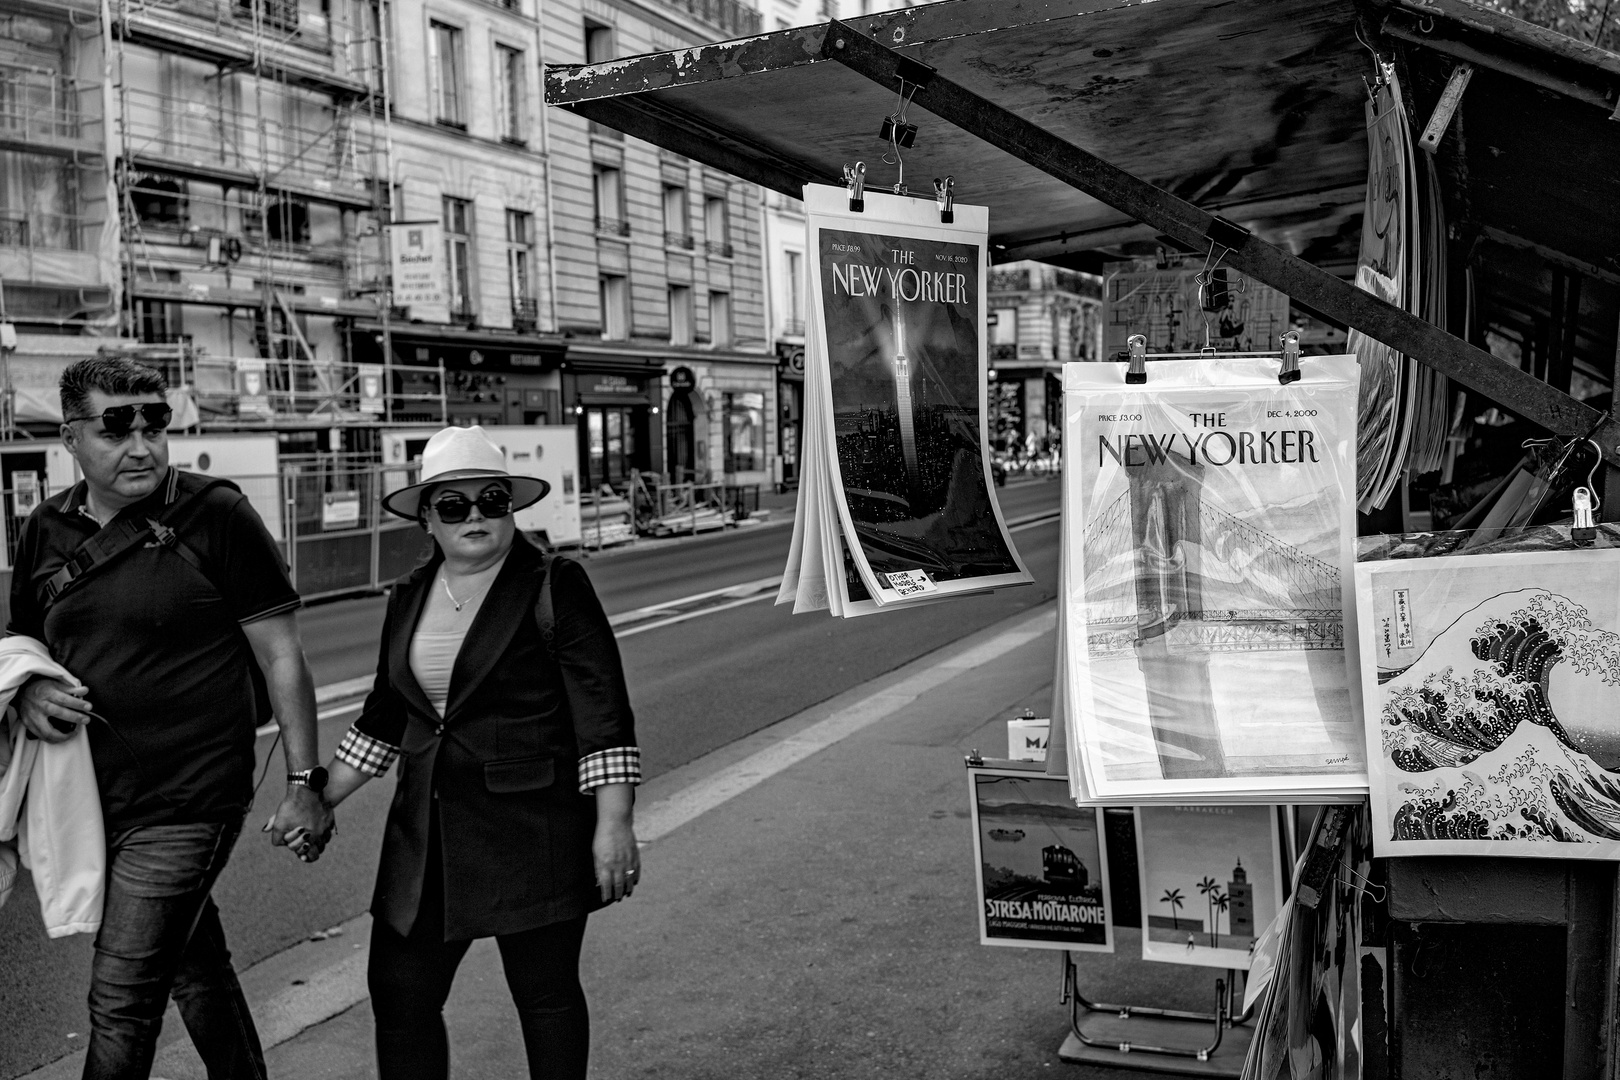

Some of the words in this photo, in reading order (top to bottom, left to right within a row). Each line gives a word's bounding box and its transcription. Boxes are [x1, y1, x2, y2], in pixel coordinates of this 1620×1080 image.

[831, 244, 846, 252] PRICE
[891, 249, 915, 265] THE
[954, 255, 968, 263] 2020
[832, 262, 883, 297] NEW
[886, 268, 968, 304] YORKER
[1098, 414, 1117, 422] PRICE
[1189, 412, 1227, 428] THE
[1267, 410, 1283, 418] DEC.
[1284, 410, 1292, 419] 4,
[1293, 409, 1318, 418] 2000
[1099, 433, 1176, 468] NEW
[1182, 430, 1319, 466] YORKER
